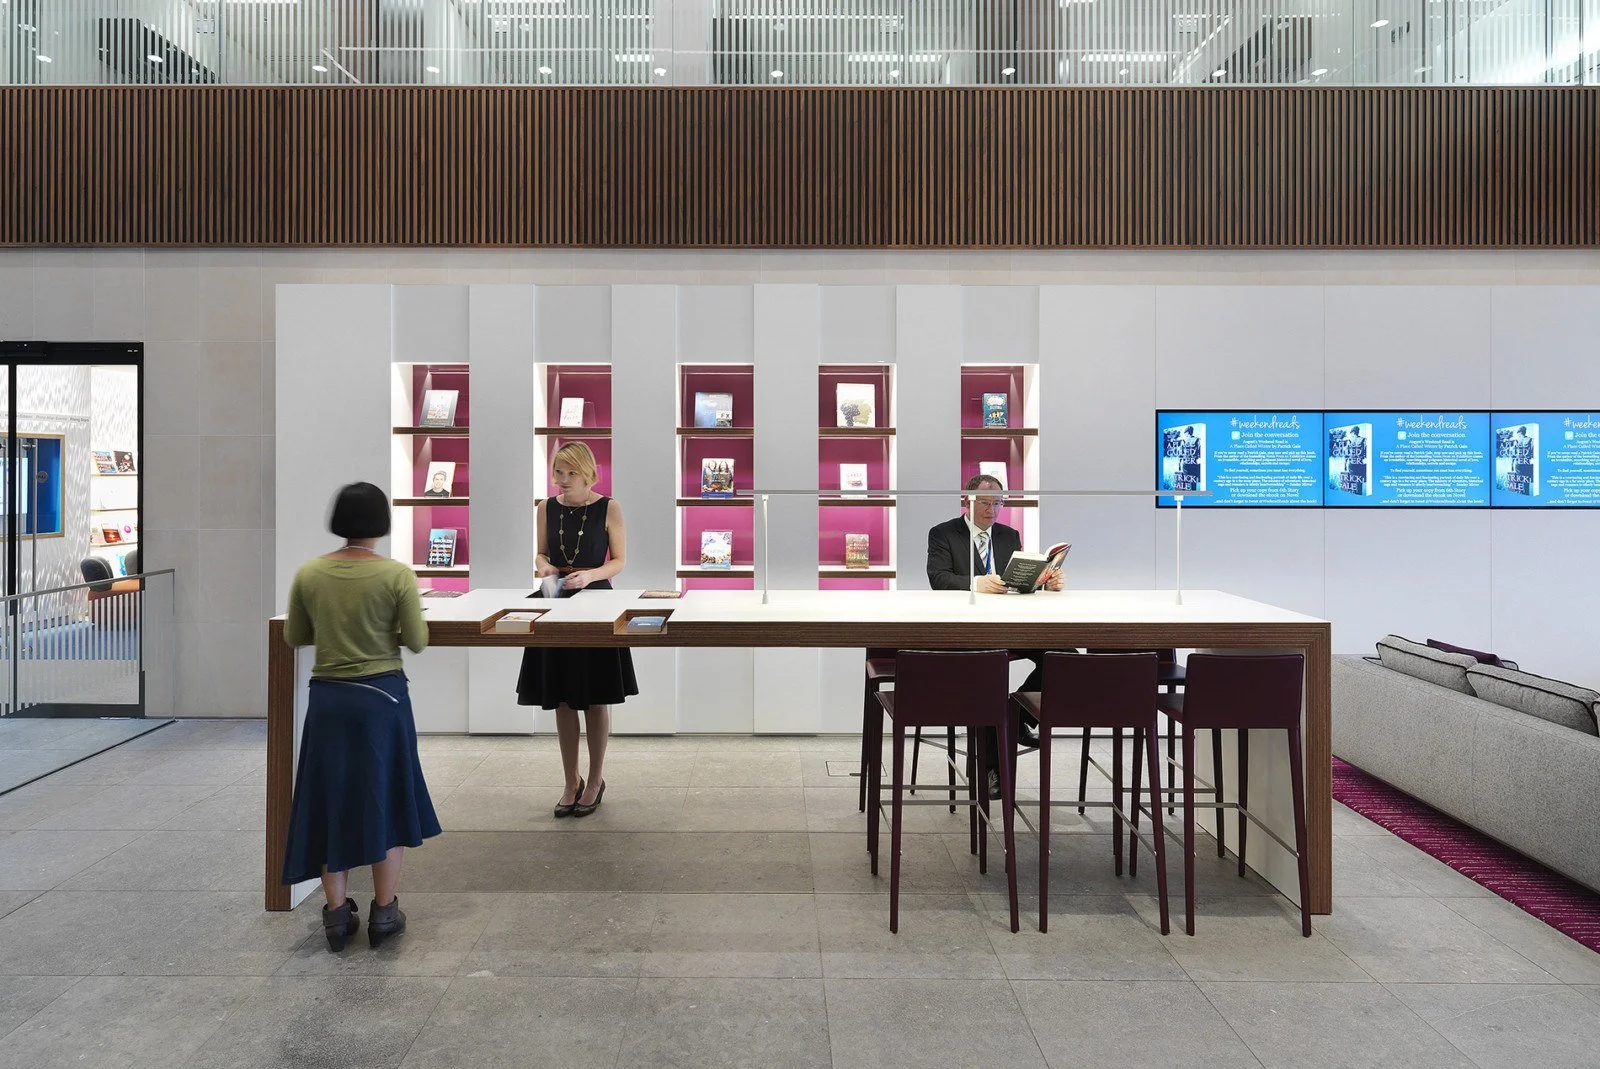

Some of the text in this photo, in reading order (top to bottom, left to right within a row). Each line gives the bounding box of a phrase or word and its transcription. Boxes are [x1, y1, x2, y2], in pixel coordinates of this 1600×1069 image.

[1230, 414, 1300, 429] #weekendreads
[1396, 414, 1468, 429] #weekendreads
[1171, 481, 1192, 490] GALE
[1337, 481, 1357, 490] GALE
[1504, 481, 1525, 490] GALE
